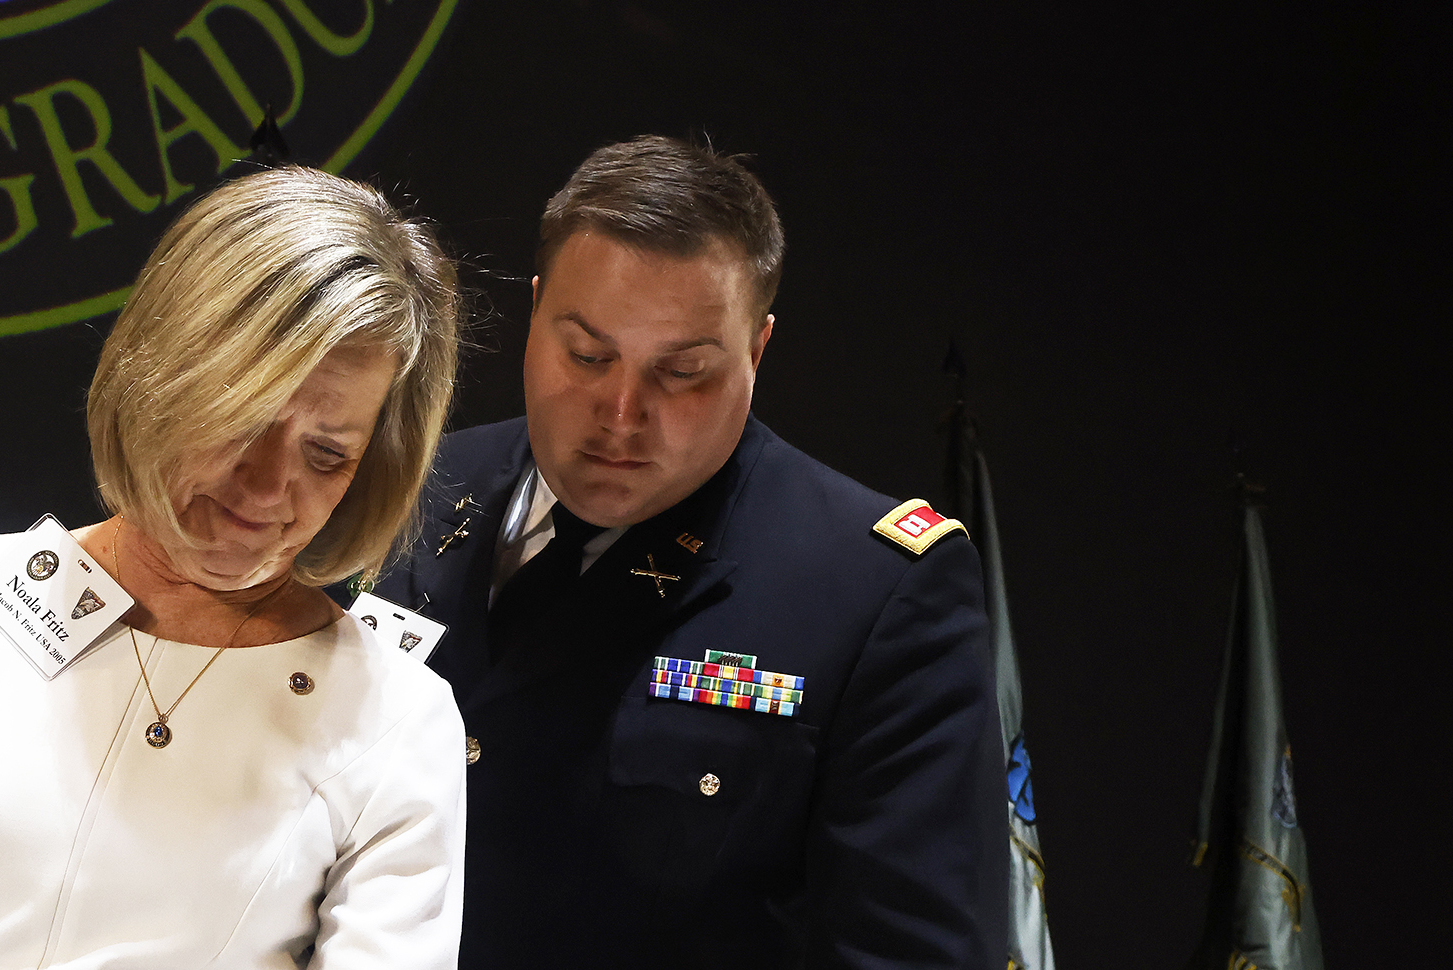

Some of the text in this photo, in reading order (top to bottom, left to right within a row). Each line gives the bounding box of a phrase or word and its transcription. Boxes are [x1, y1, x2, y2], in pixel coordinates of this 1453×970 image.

[6, 574, 42, 614] Noala
[40, 609, 69, 642] Fritz
[12, 609, 22, 621] N.
[20, 618, 37, 636] Fritz
[35, 633, 52, 651] USA
[49, 647, 66, 665] 2005
